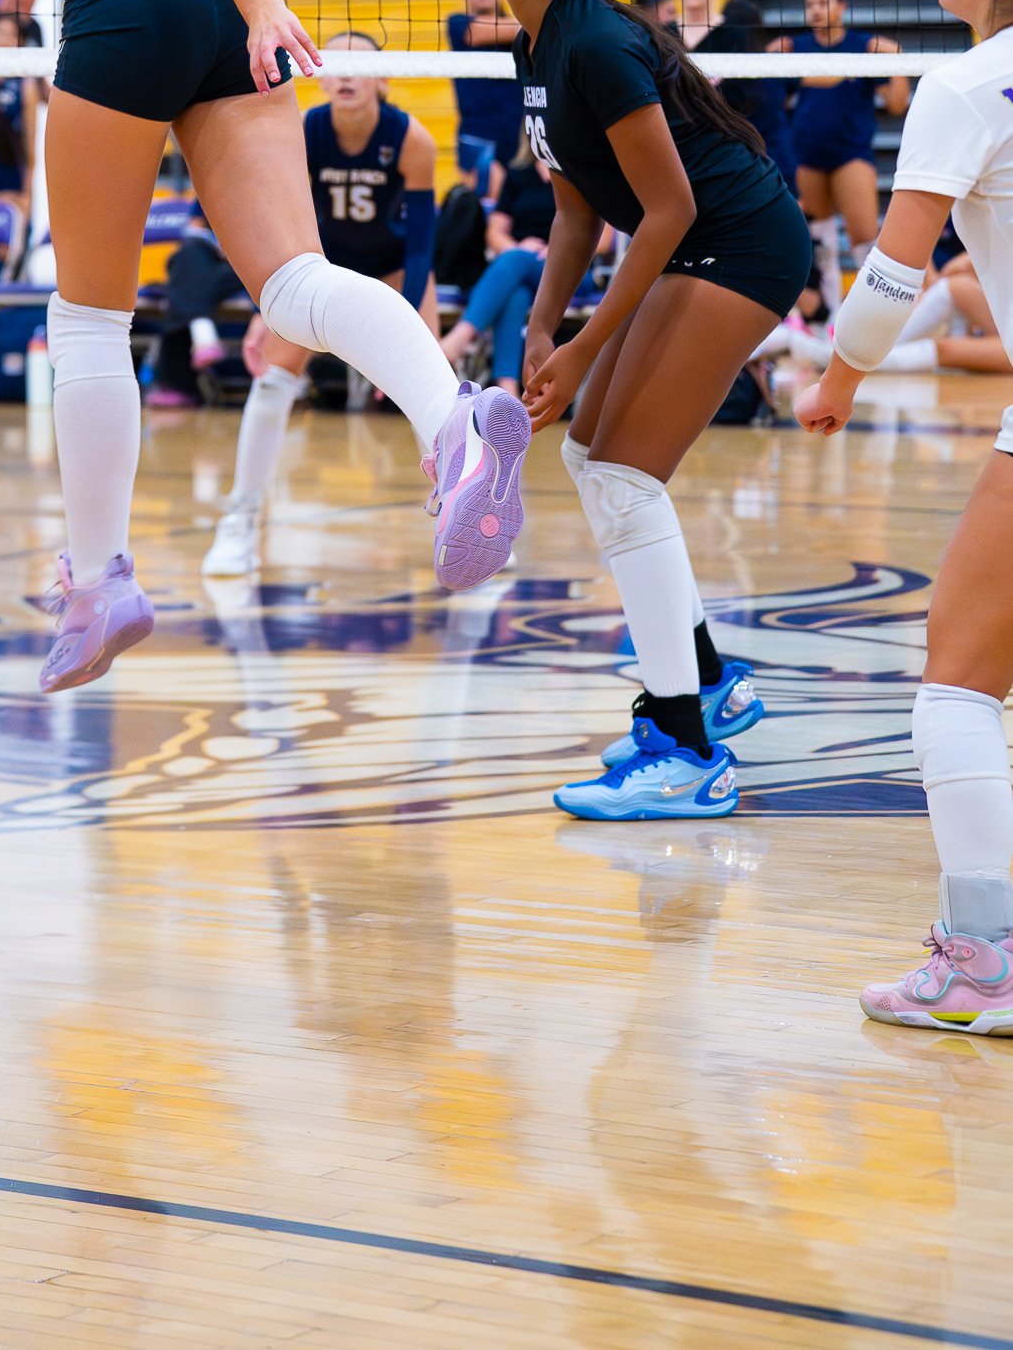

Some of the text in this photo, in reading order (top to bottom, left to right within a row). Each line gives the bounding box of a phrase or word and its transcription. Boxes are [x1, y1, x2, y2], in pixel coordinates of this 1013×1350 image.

[524, 114, 563, 171] 26
[328, 185, 377, 222] 15
[870, 268, 916, 302] Tandem
